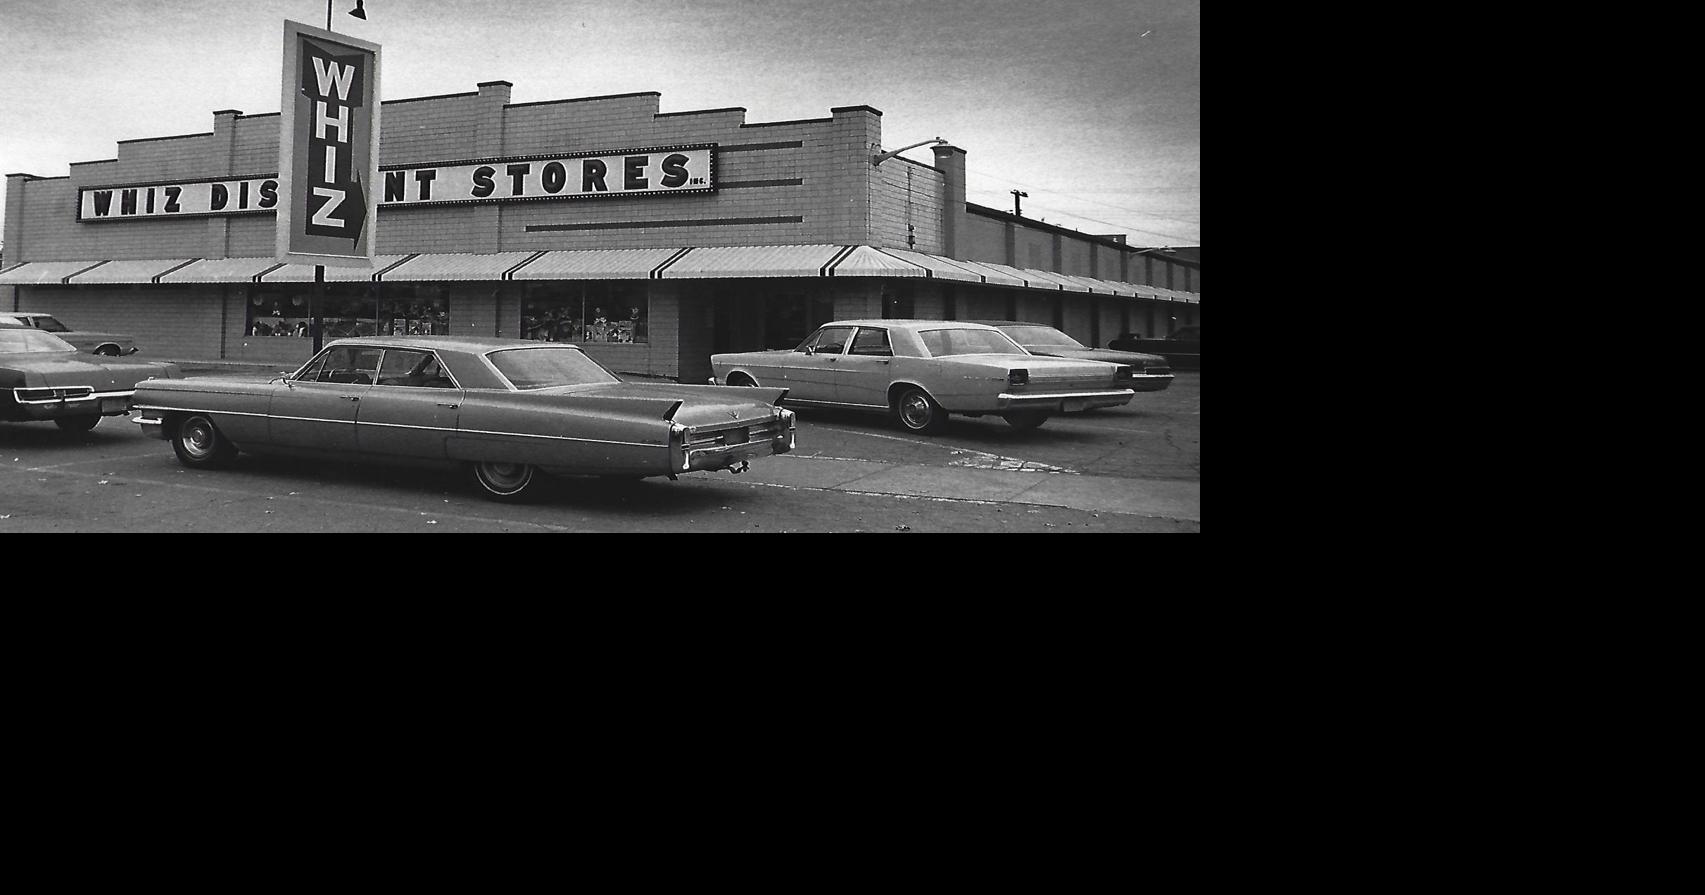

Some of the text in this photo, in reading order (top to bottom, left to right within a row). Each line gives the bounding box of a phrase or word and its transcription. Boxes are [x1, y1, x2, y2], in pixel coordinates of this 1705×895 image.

[93, 186, 182, 217] WHIZ
[210, 168, 437, 212] DISNT
[470, 153, 690, 198] STORES
[311, 56, 355, 228] WHIZ
